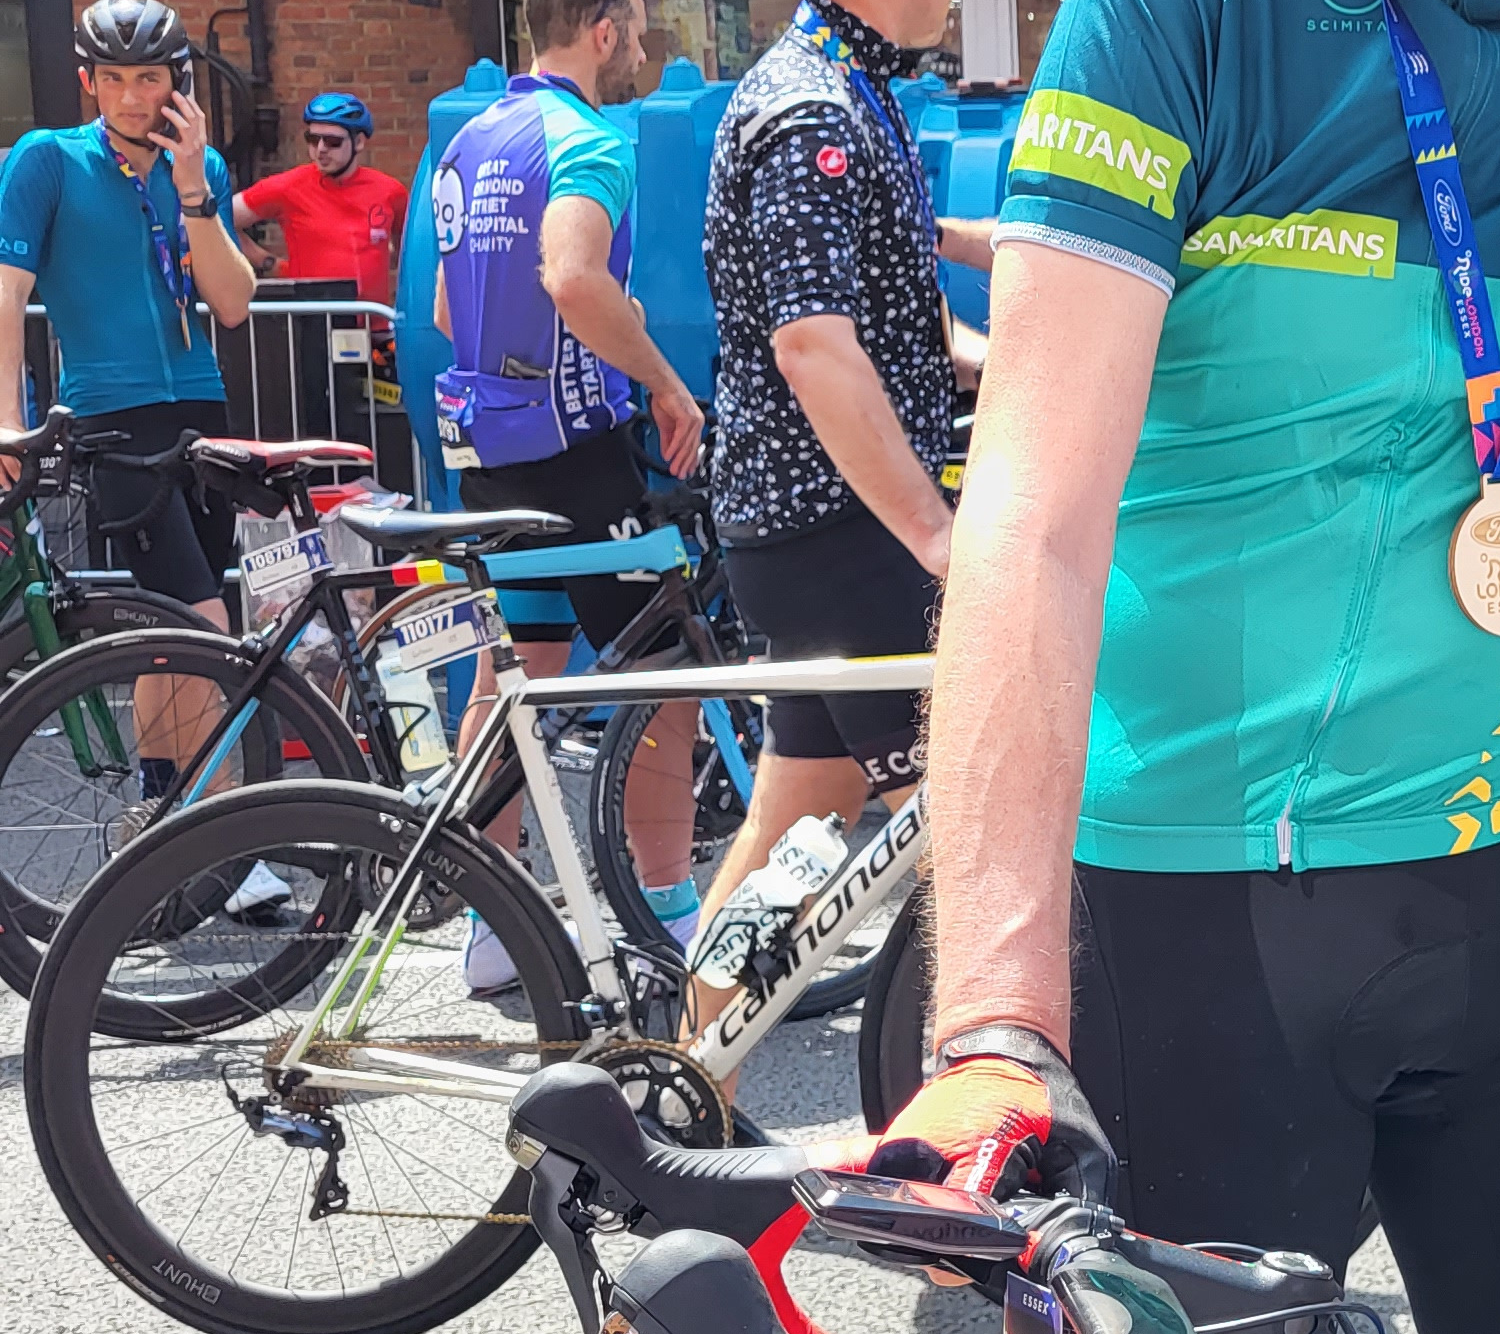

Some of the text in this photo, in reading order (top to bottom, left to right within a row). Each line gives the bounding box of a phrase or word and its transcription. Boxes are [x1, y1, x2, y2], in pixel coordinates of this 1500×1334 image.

[1306, 18, 1388, 34] SCIMITA
[1017, 112, 1172, 191] ARITANS
[468, 216, 530, 236] HOSPITAL
[1436, 193, 1458, 234] Ford
[1184, 222, 1386, 262] SAMARITANS
[1455, 299, 1472, 340] ESSEX
[247, 538, 300, 571] 108797
[400, 607, 455, 645] 110177
[719, 808, 922, 1049] cannonda
[1022, 1293, 1050, 1316] ESSEX
